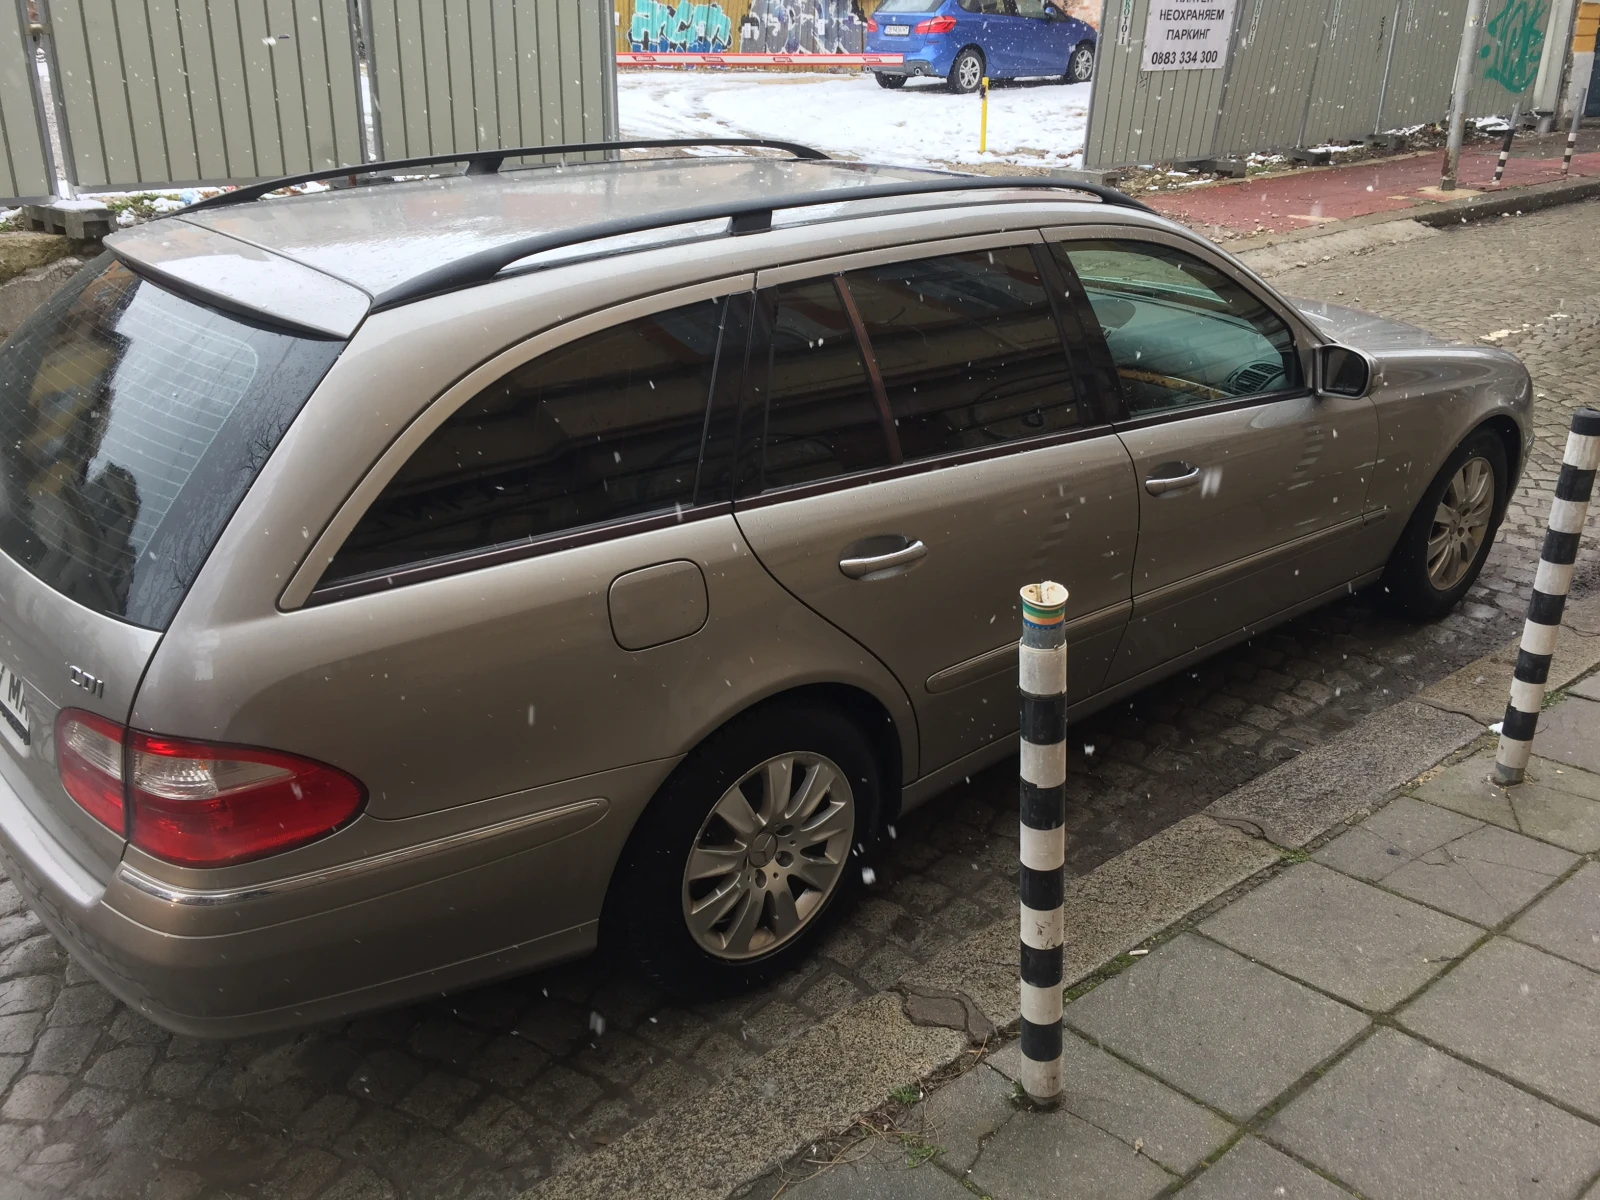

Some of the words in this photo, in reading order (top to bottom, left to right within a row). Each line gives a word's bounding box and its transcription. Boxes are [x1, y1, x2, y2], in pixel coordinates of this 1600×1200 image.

[1159, 9, 1225, 21] НЕОХРАНЯЕМ
[1166, 28, 1211, 40] ПАРКИНГ
[1151, 51, 1177, 65] 0883
[1179, 50, 1198, 64] 334
[1200, 50, 1218, 63] 300
[69, 665, 104, 699] CDI
